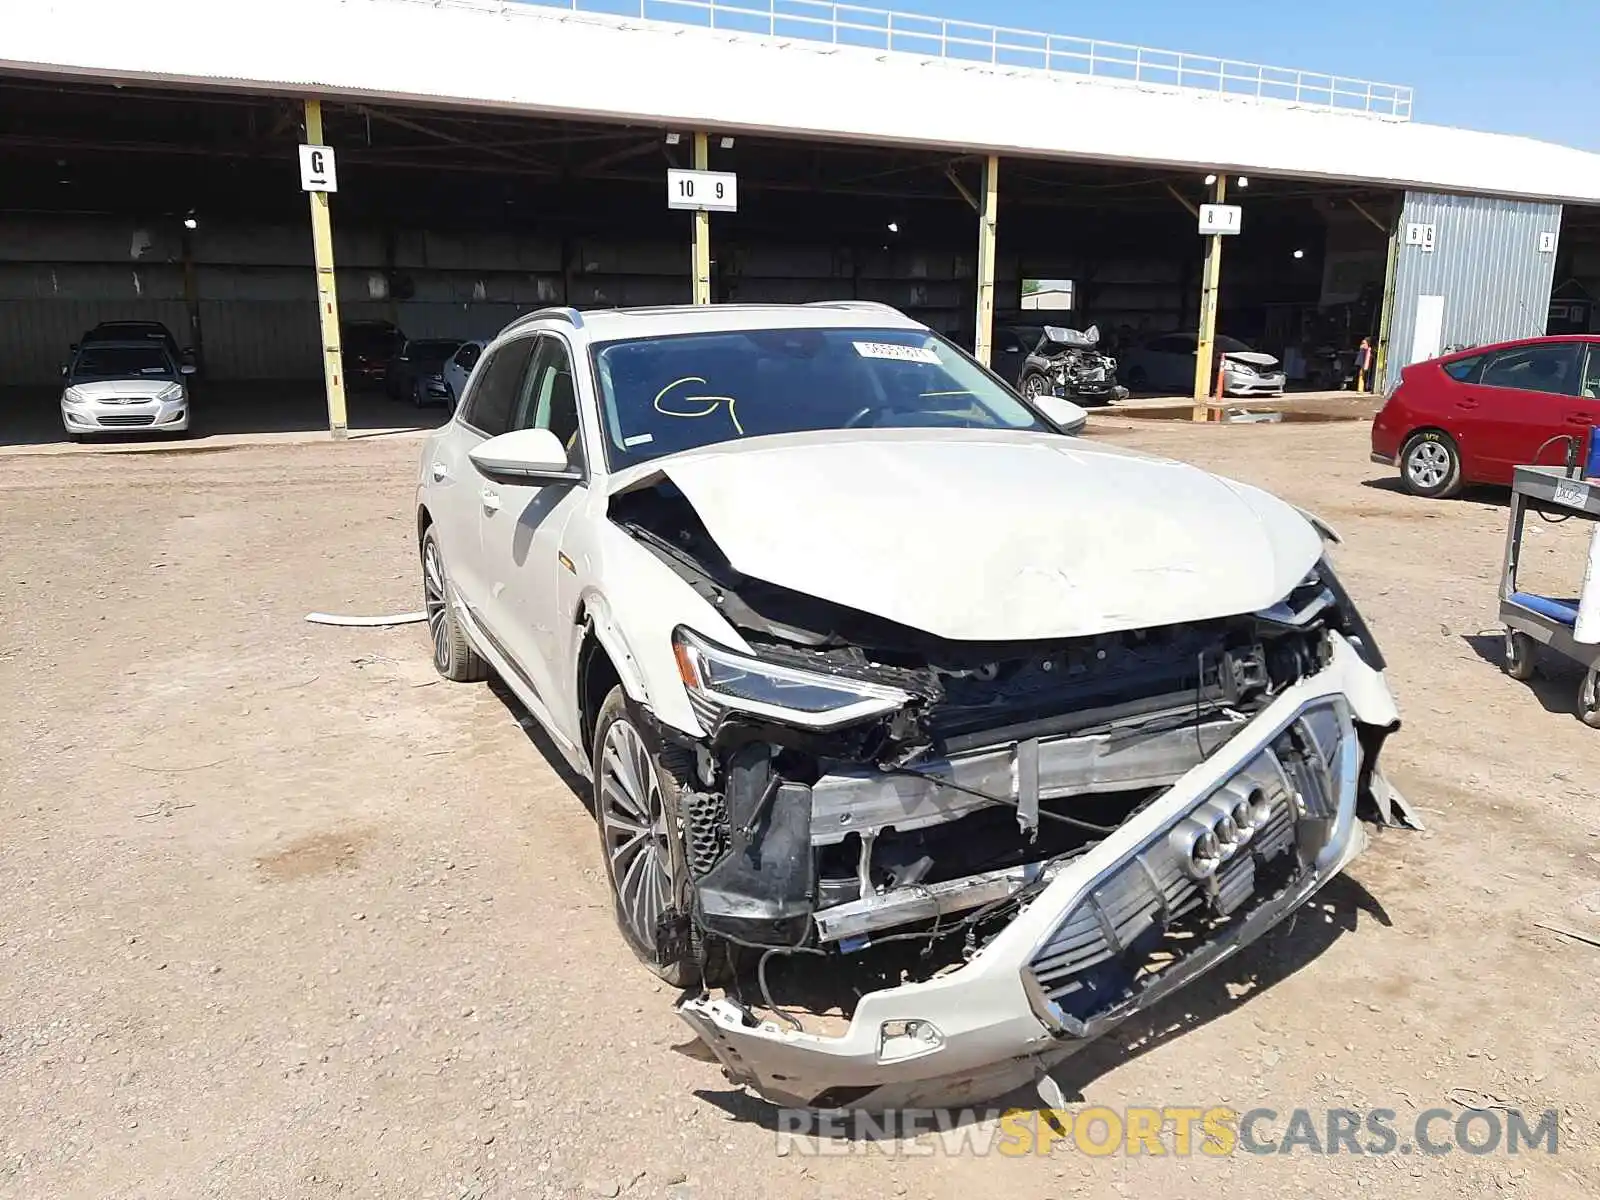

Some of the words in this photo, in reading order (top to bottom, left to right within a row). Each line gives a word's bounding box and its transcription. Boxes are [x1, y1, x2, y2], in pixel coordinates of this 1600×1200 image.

[311, 150, 325, 174] G
[678, 179, 694, 198] 10
[715, 181, 724, 200] 9
[1207, 210, 1214, 224] 8
[1228, 211, 1233, 225] 7
[654, 376, 744, 435] G
